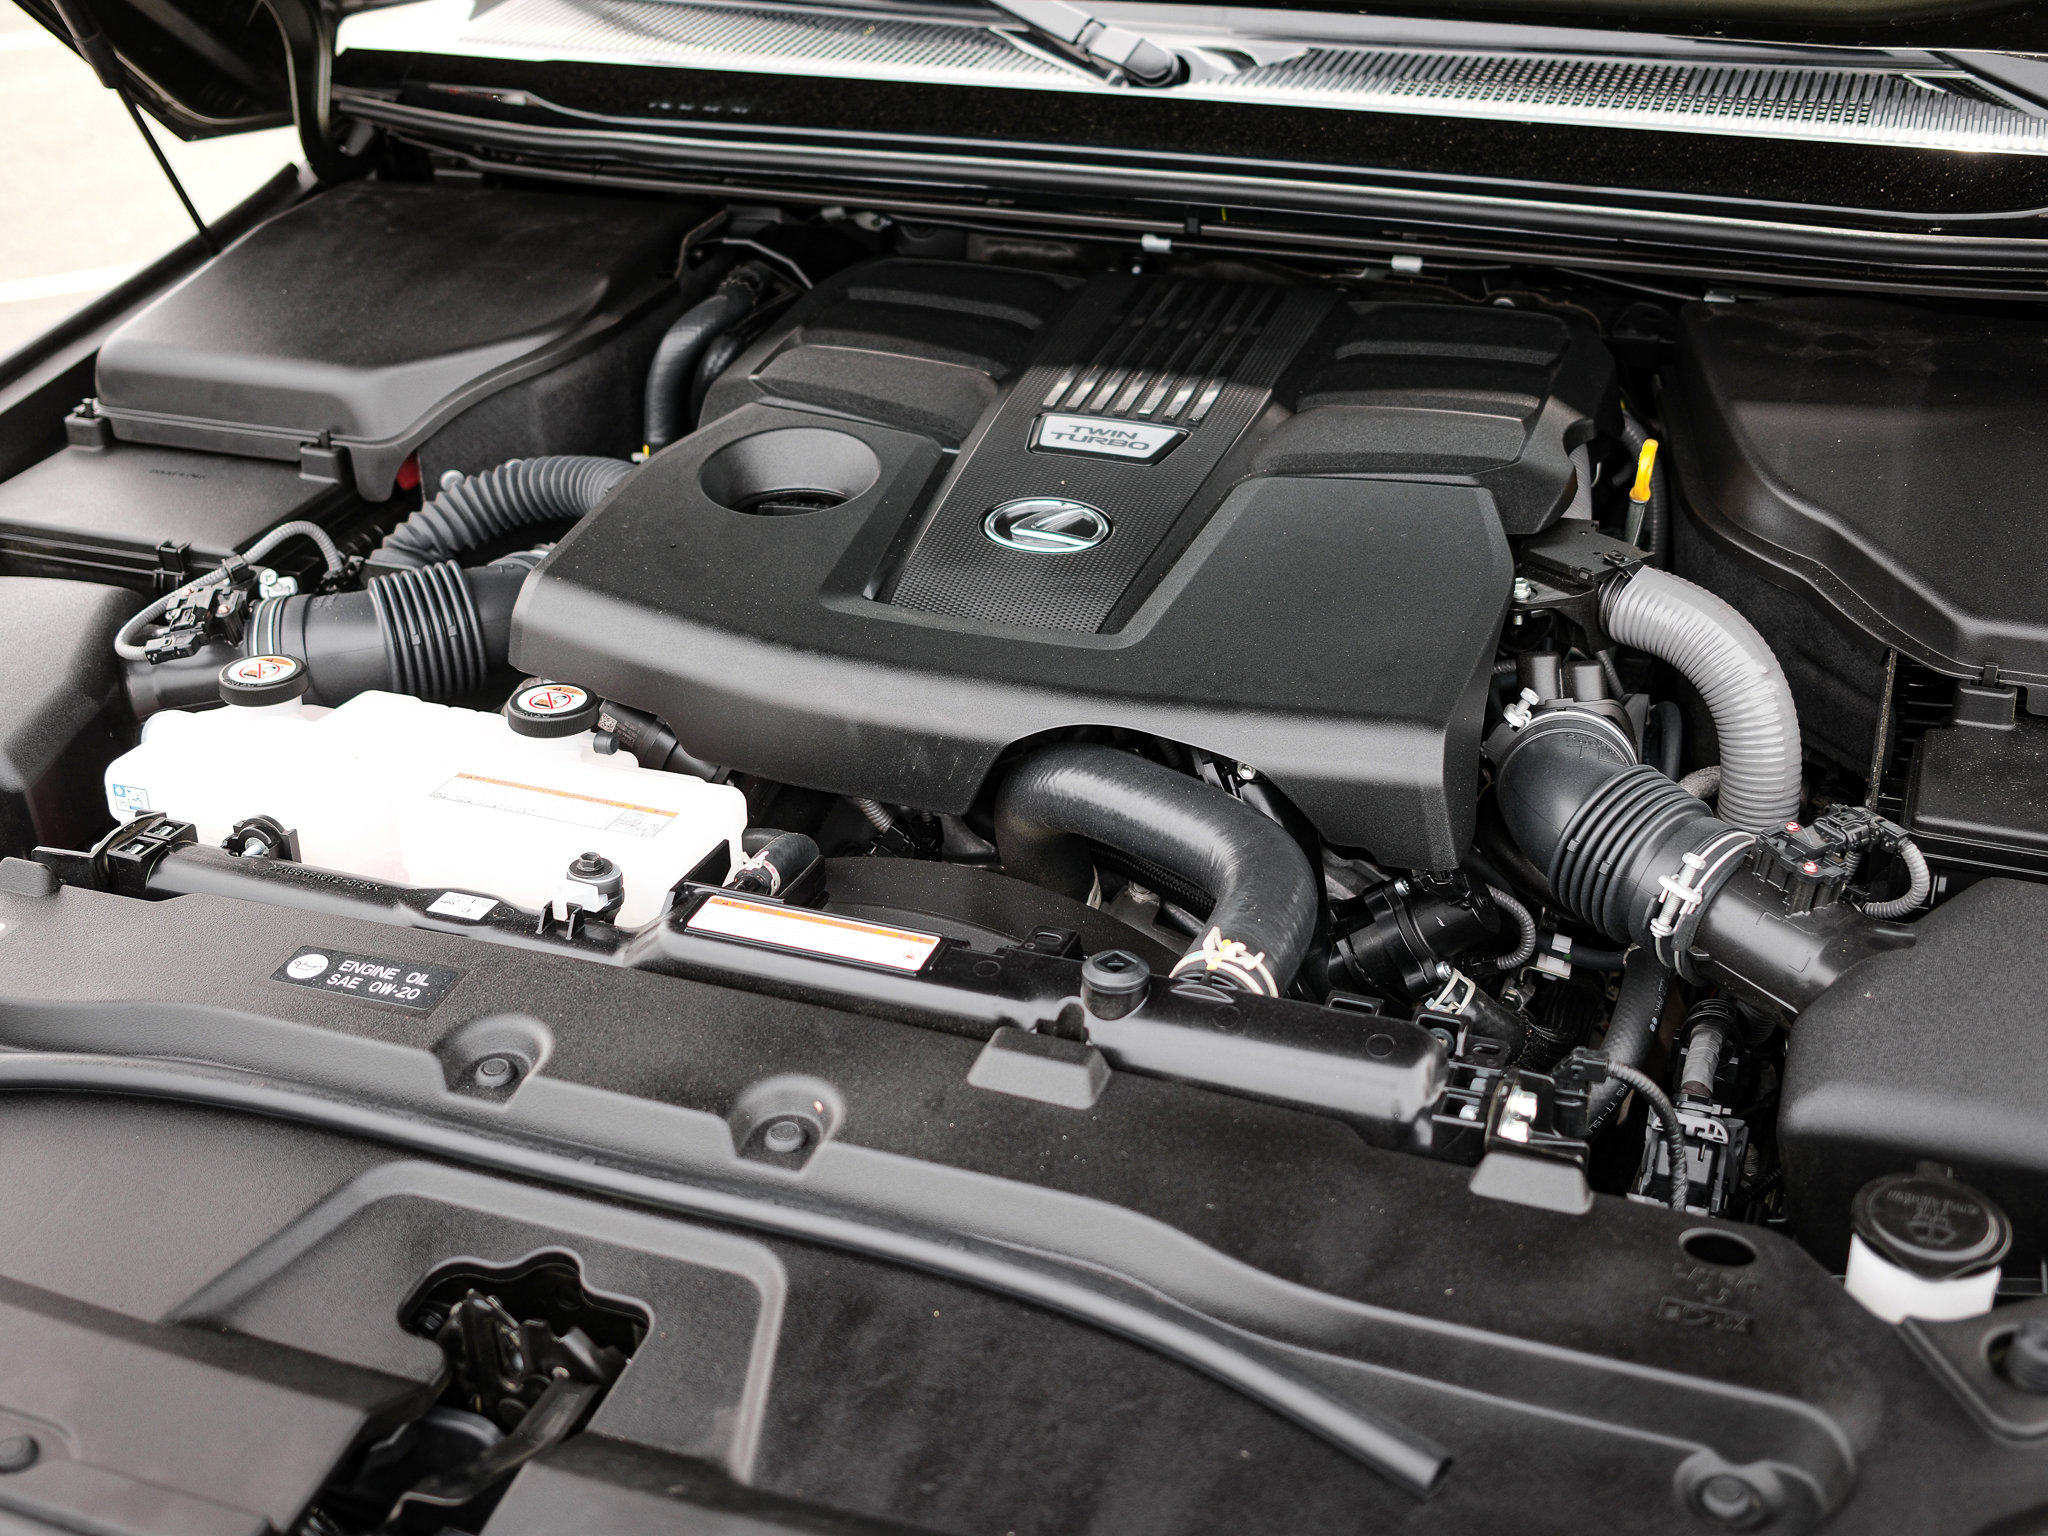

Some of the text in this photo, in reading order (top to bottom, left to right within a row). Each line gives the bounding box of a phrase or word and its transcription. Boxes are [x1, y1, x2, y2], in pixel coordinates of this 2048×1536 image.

[1050, 431, 1150, 451] TURBO
[1069, 424, 1138, 440] TWIN
[338, 959, 430, 987] ENGINE OIL
[326, 973, 421, 1000] SAE 0W-20
